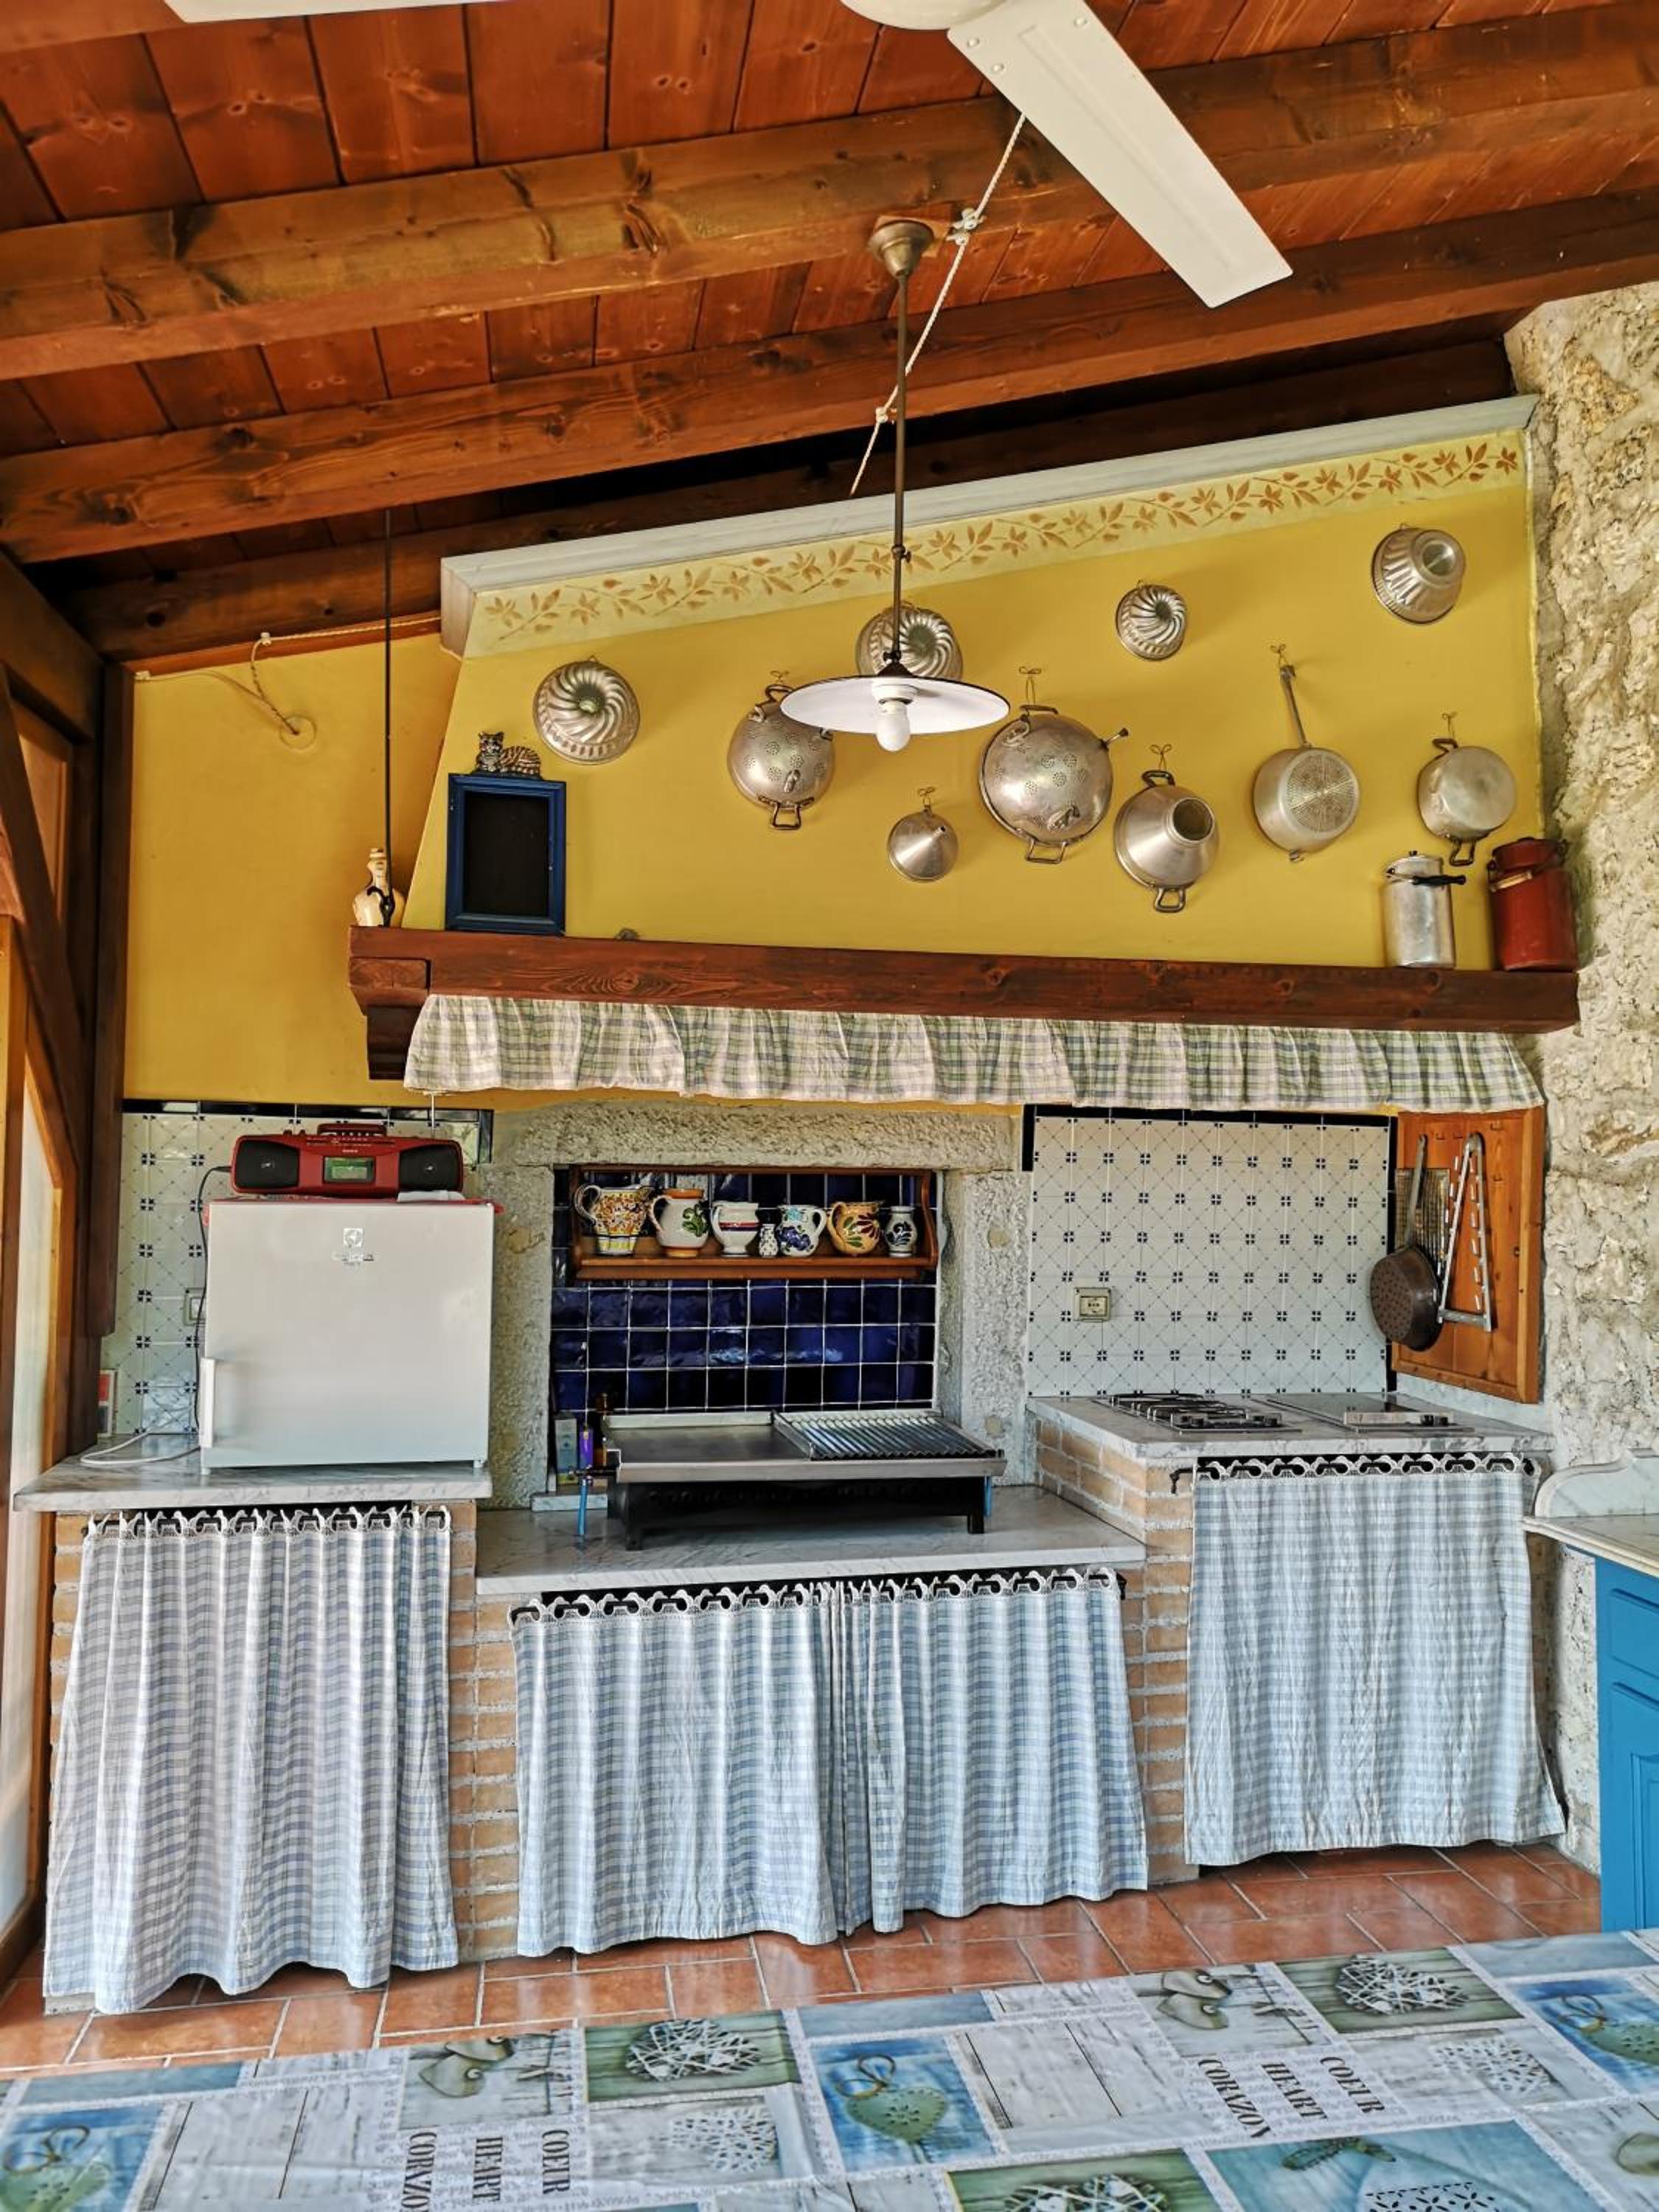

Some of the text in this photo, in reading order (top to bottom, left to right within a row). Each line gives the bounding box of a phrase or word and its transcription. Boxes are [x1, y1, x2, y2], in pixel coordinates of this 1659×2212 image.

[1262, 2063, 1328, 2119] HEART
[1320, 2056, 1386, 2114] COEUR
[400, 2132, 437, 2212] CORAZO
[472, 2137, 504, 2202] HEART
[542, 2130, 570, 2194] COEUR
